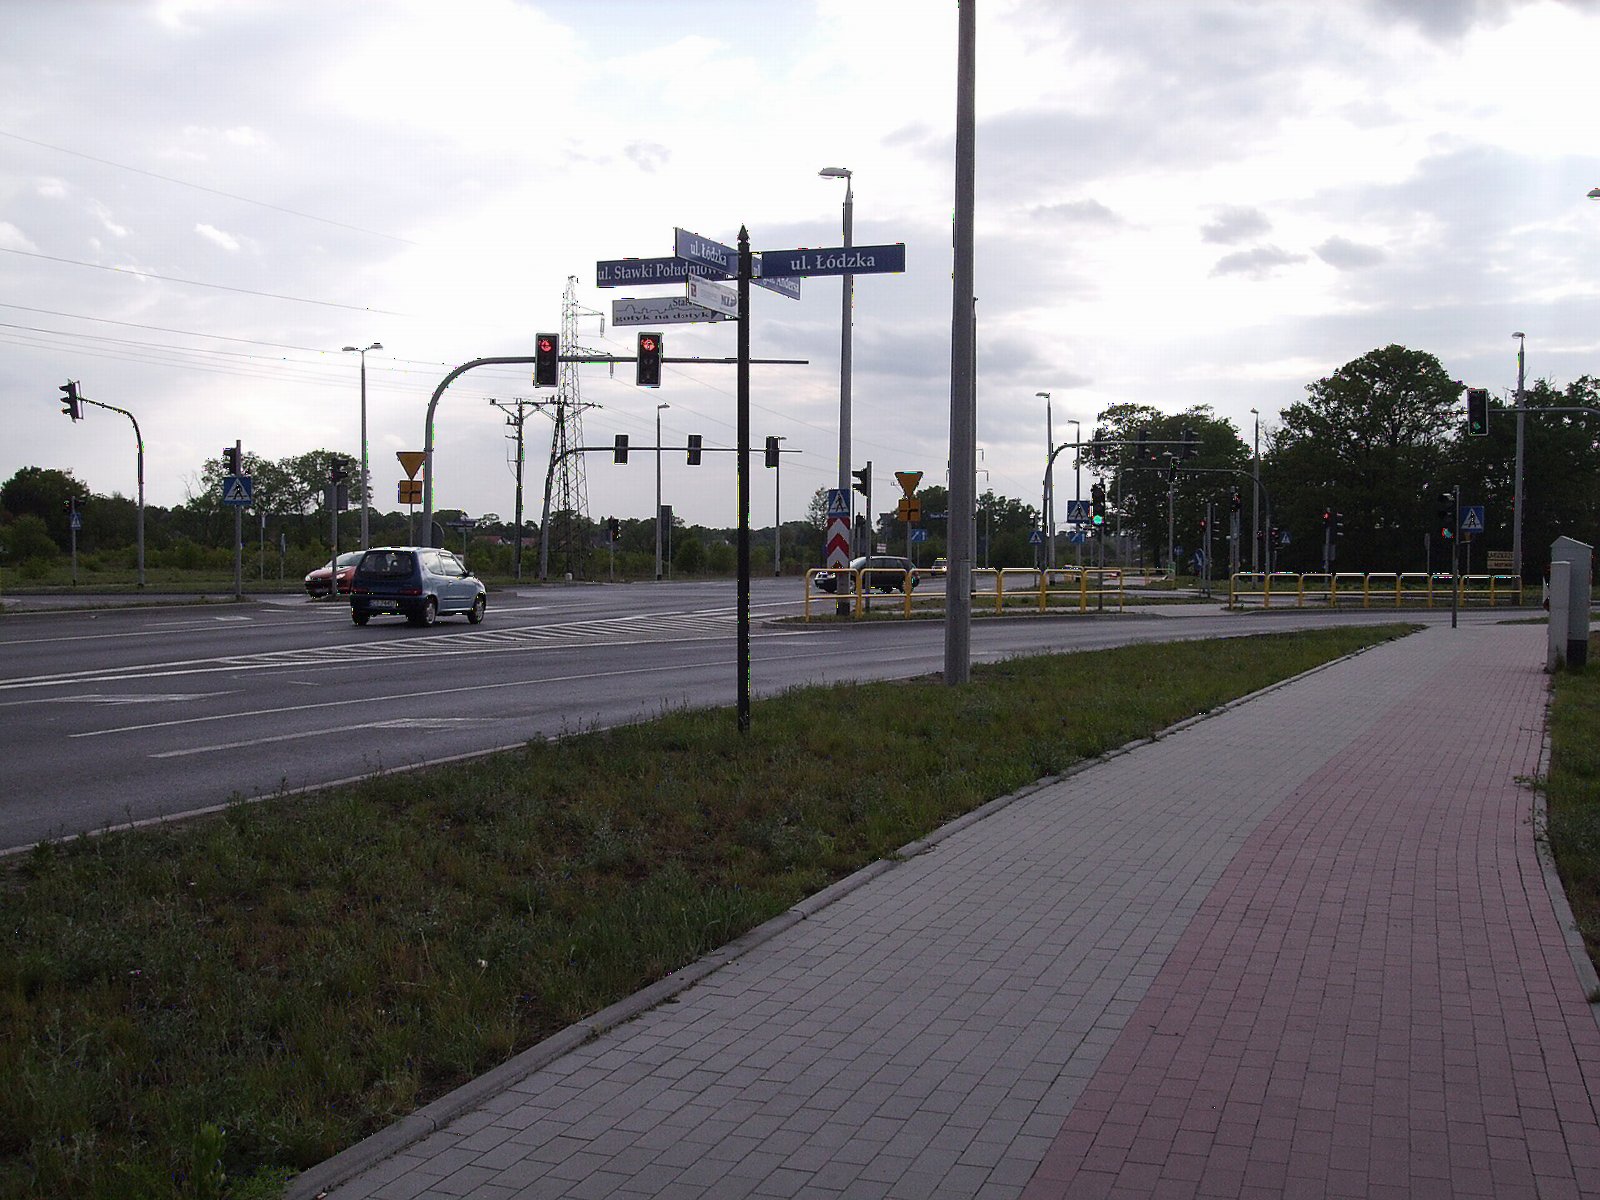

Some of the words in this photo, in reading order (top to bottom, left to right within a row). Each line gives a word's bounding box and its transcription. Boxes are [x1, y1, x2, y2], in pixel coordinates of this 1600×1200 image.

[690, 241, 701, 257] ul.
[701, 243, 727, 267] Łódzka
[790, 256, 810, 271] ul.
[815, 252, 876, 269] Łódzka
[598, 267, 611, 280] ul.
[614, 264, 653, 279] Stawki
[615, 313, 650, 323] gotyk
[673, 311, 709, 320] dotyk
